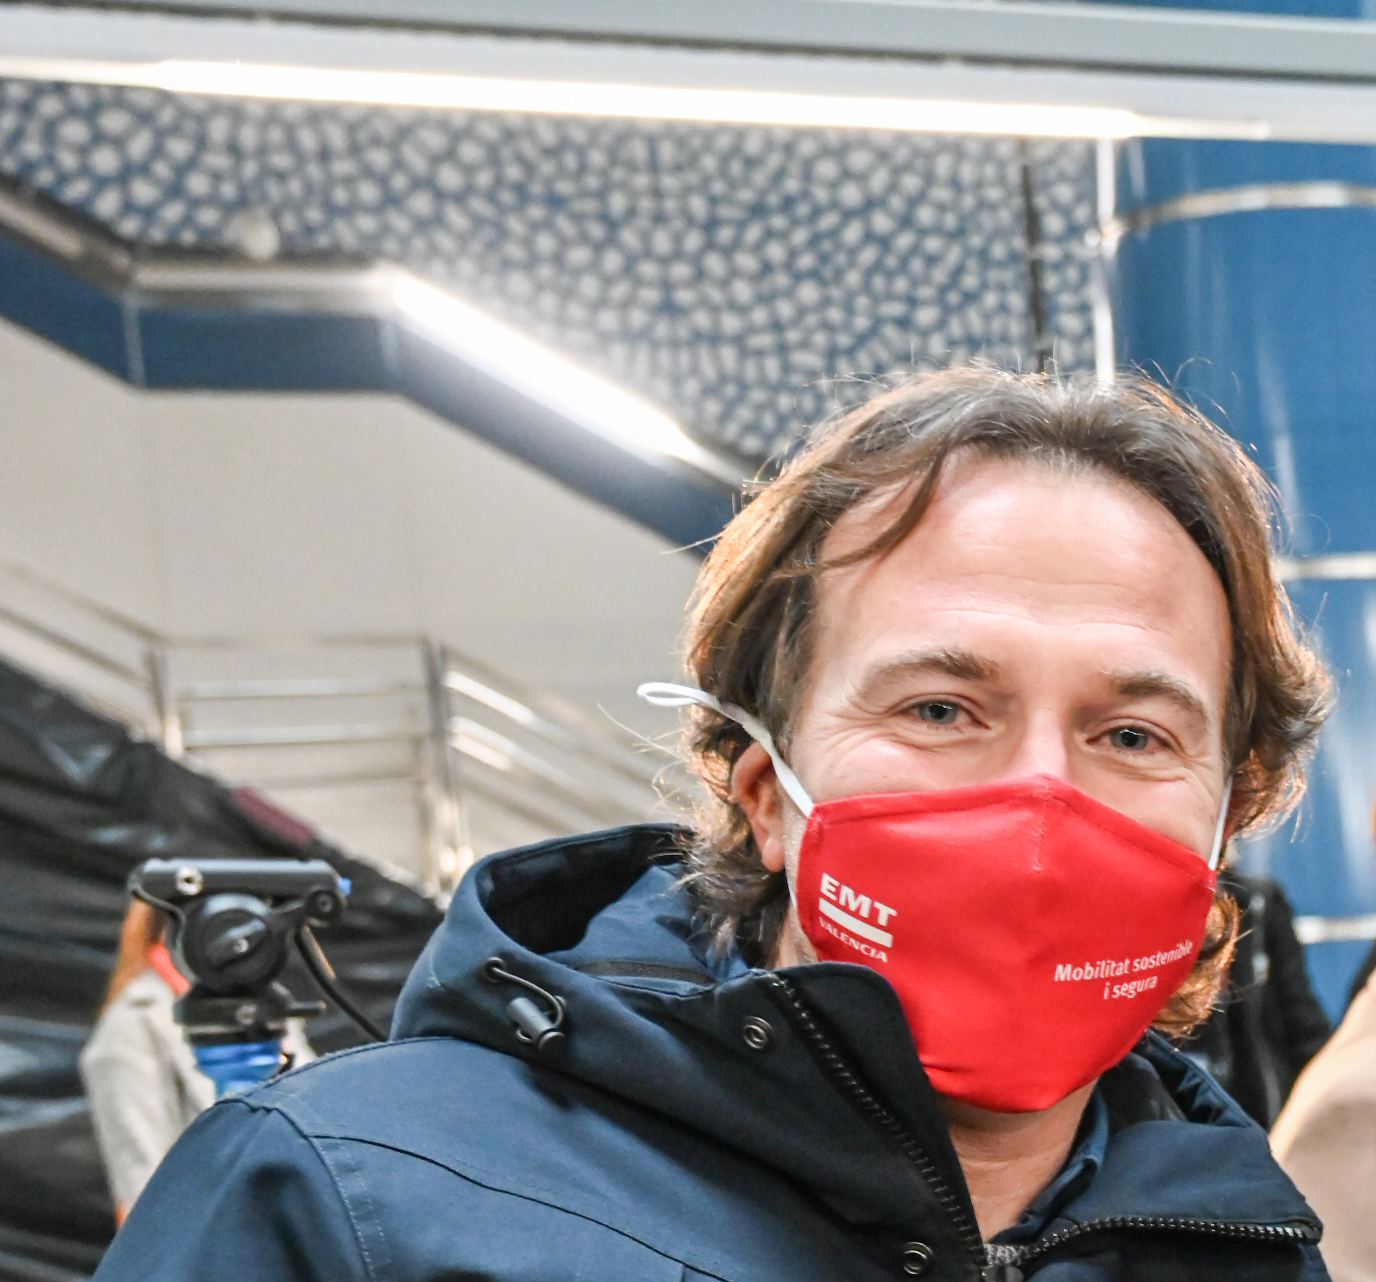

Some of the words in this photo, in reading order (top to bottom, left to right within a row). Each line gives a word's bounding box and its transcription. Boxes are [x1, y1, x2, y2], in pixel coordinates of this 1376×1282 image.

[820, 872, 898, 927] EMT
[819, 916, 888, 963] VALENCIA
[1054, 957, 1131, 982] Mobilitat
[1132, 939, 1194, 973] sostenible
[1103, 981, 1111, 1000] i
[1112, 975, 1159, 999] segura
